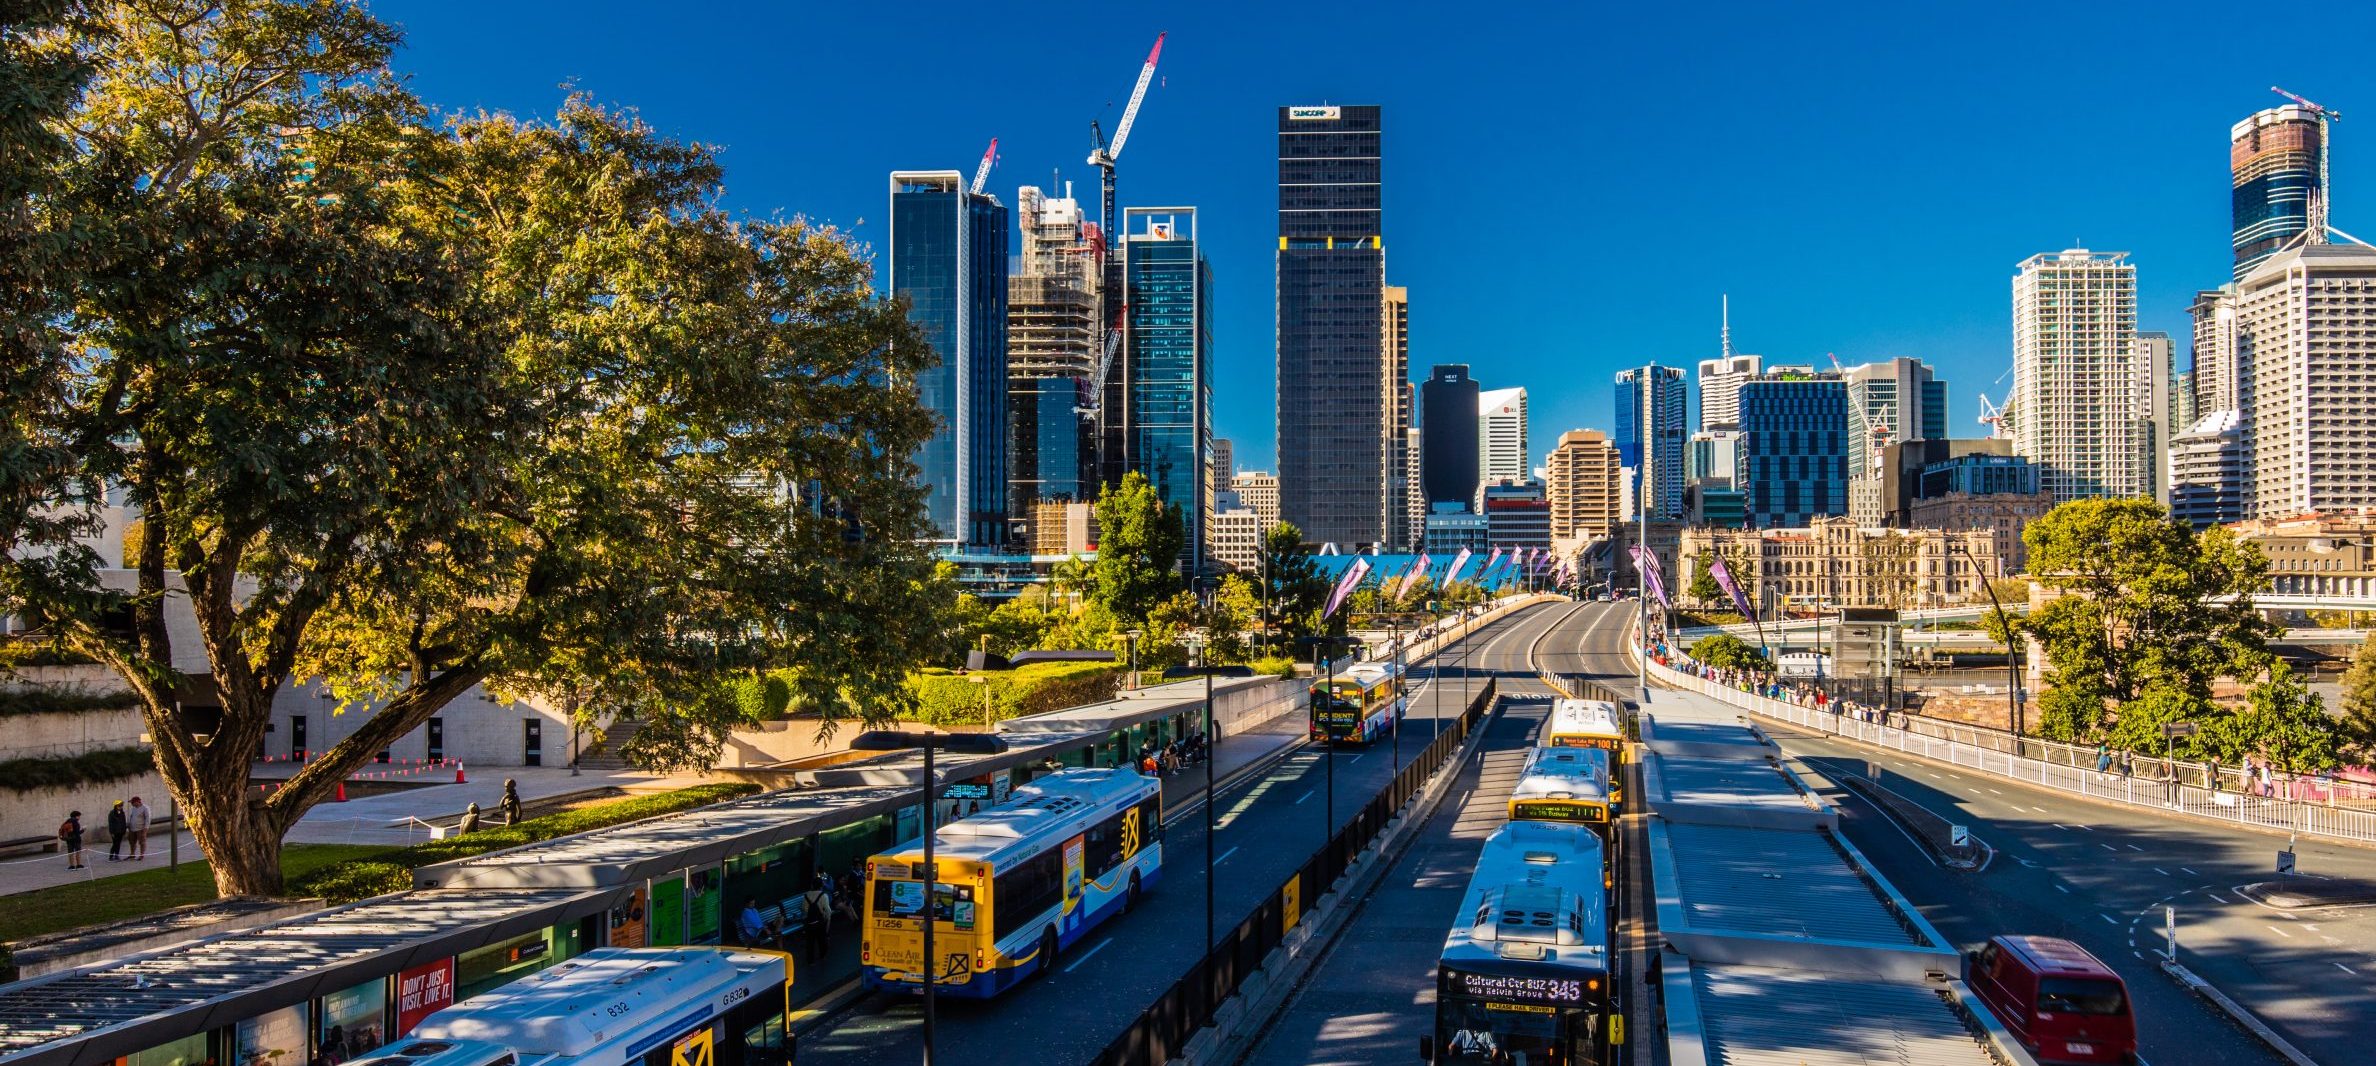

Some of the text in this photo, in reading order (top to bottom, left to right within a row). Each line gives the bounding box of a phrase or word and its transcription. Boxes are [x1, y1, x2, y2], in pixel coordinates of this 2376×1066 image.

[1597, 740, 1611, 748] 100
[876, 920, 902, 928] T1256
[402, 968, 446, 996] DON'T JUST
[1465, 975, 1580, 1000] Cultural Ctr BUZ 345
[402, 983, 450, 1012] VISIT, LIVE IT.
[1469, 986, 1543, 999] via Kelvin Grove
[606, 1001, 631, 1017] 832
